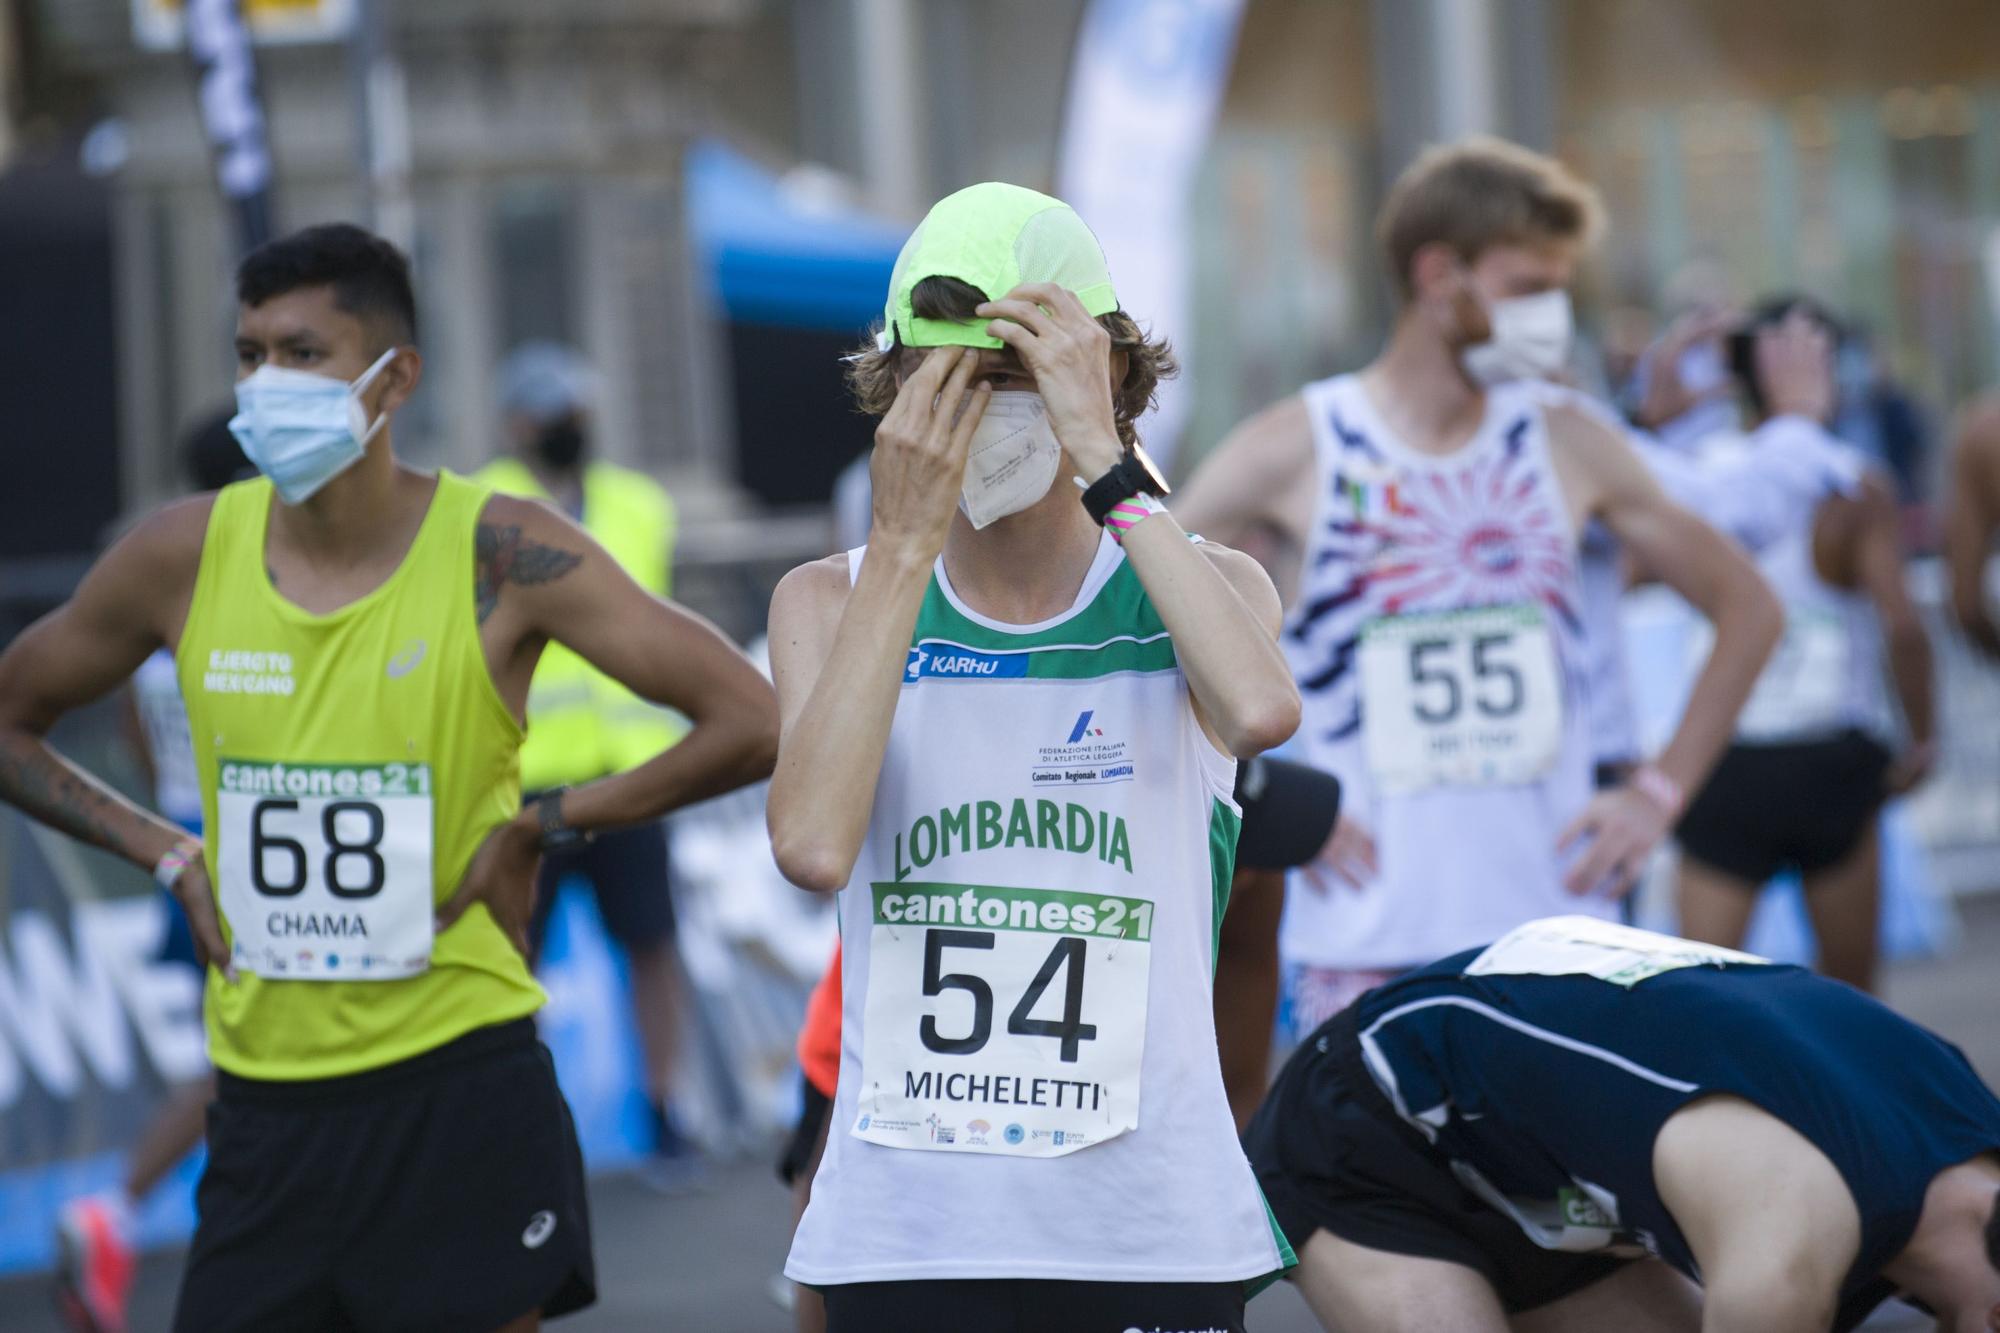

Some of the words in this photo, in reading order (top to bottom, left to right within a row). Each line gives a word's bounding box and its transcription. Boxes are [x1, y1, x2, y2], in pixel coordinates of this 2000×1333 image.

[209, 649, 293, 673] EJERCITO
[930, 655, 999, 675] KARHU
[203, 671, 295, 696] MEXICANO
[1410, 635, 1524, 724] 55
[1039, 745, 1092, 755] FEDERAZIONE
[1094, 741, 1126, 752] ITALIANA
[1053, 754, 1091, 762] ATLETICA
[1093, 750, 1123, 760] LEGGERA
[221, 762, 431, 796] cantones21
[1032, 771, 1062, 782] Comitato
[1065, 770, 1096, 783] Regionale
[1101, 765, 1134, 779] LOMBARDIA
[251, 796, 385, 900] 68
[895, 798, 1133, 882] LOMBARDIA
[266, 911, 368, 938] CHAMA
[881, 889, 1153, 940] cantones21
[919, 928, 1097, 1064] 54
[904, 1070, 1100, 1111] MICHELETTI
